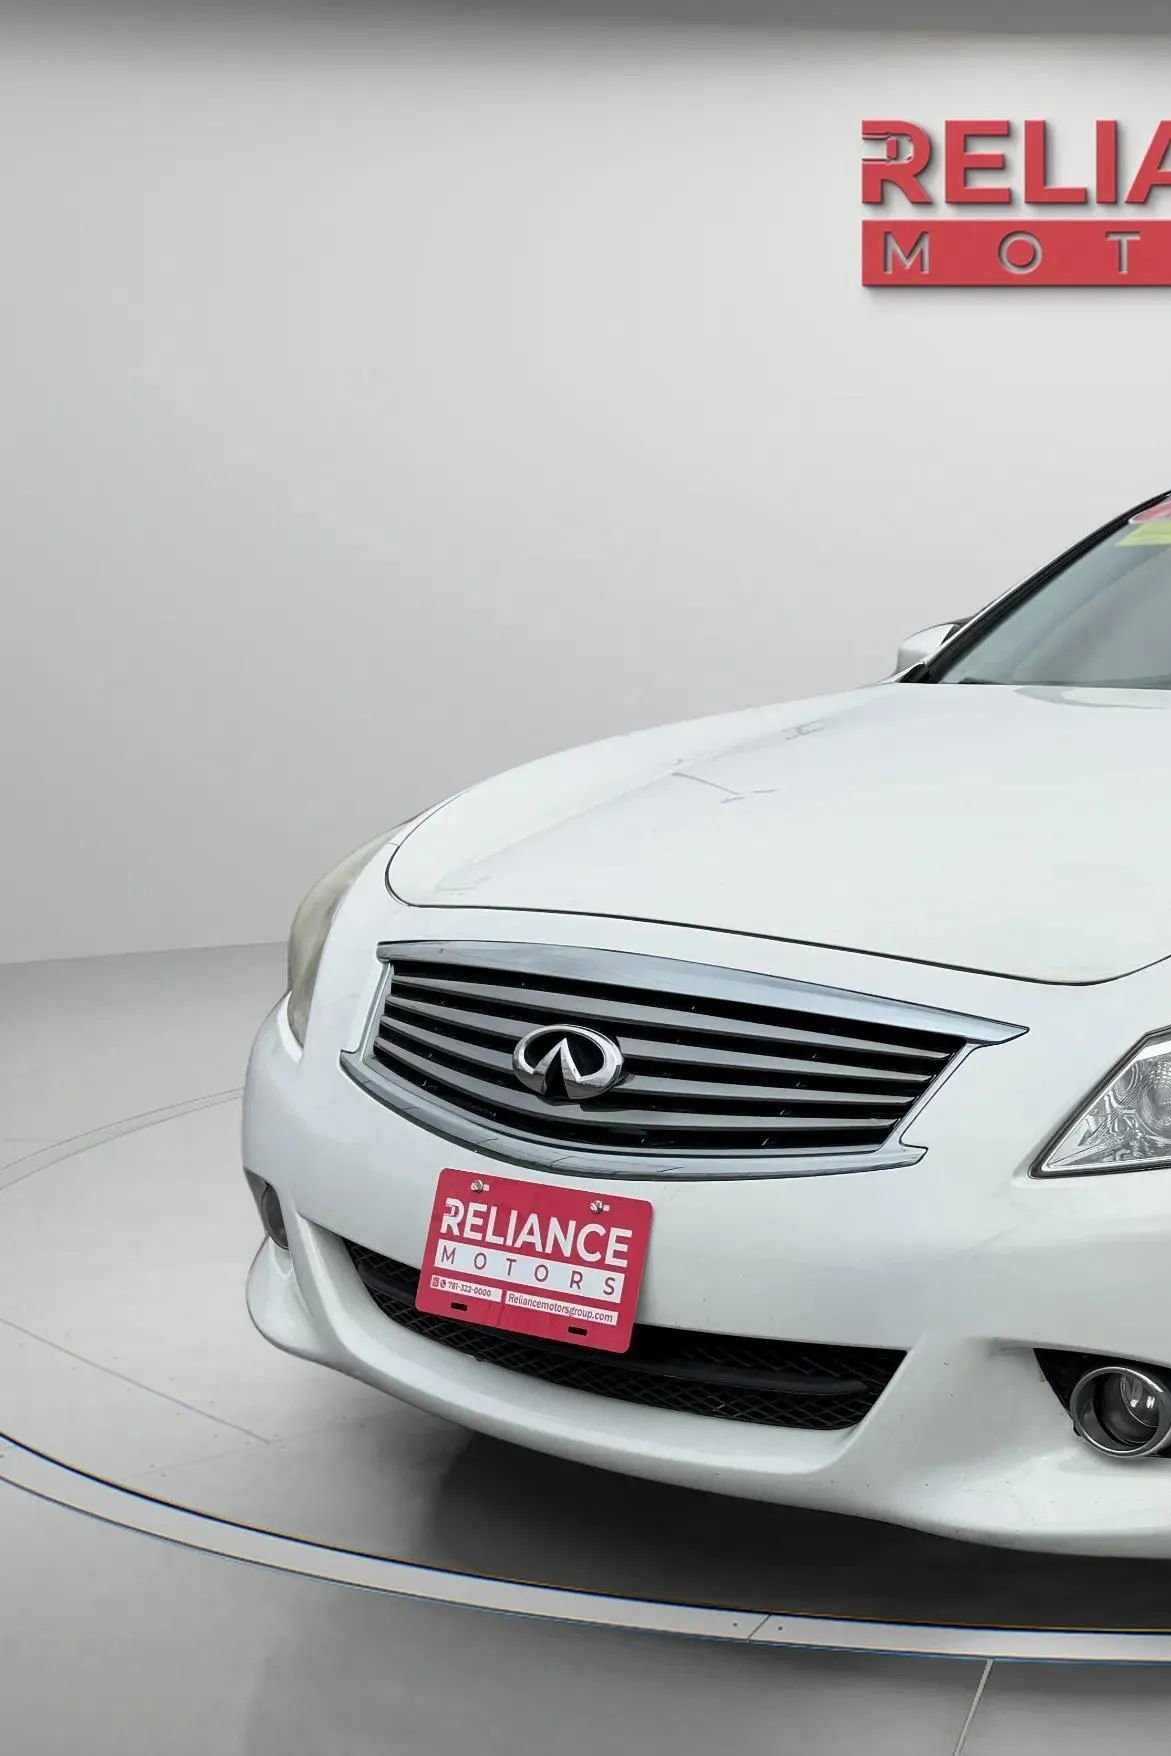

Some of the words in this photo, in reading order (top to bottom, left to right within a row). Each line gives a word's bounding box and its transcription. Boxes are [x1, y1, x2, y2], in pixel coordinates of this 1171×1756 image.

[440, 1198, 632, 1268] RELIANCE
[441, 1245, 615, 1296] MOTORS
[508, 1293, 613, 1323] Reliancemotorsgroup.com
